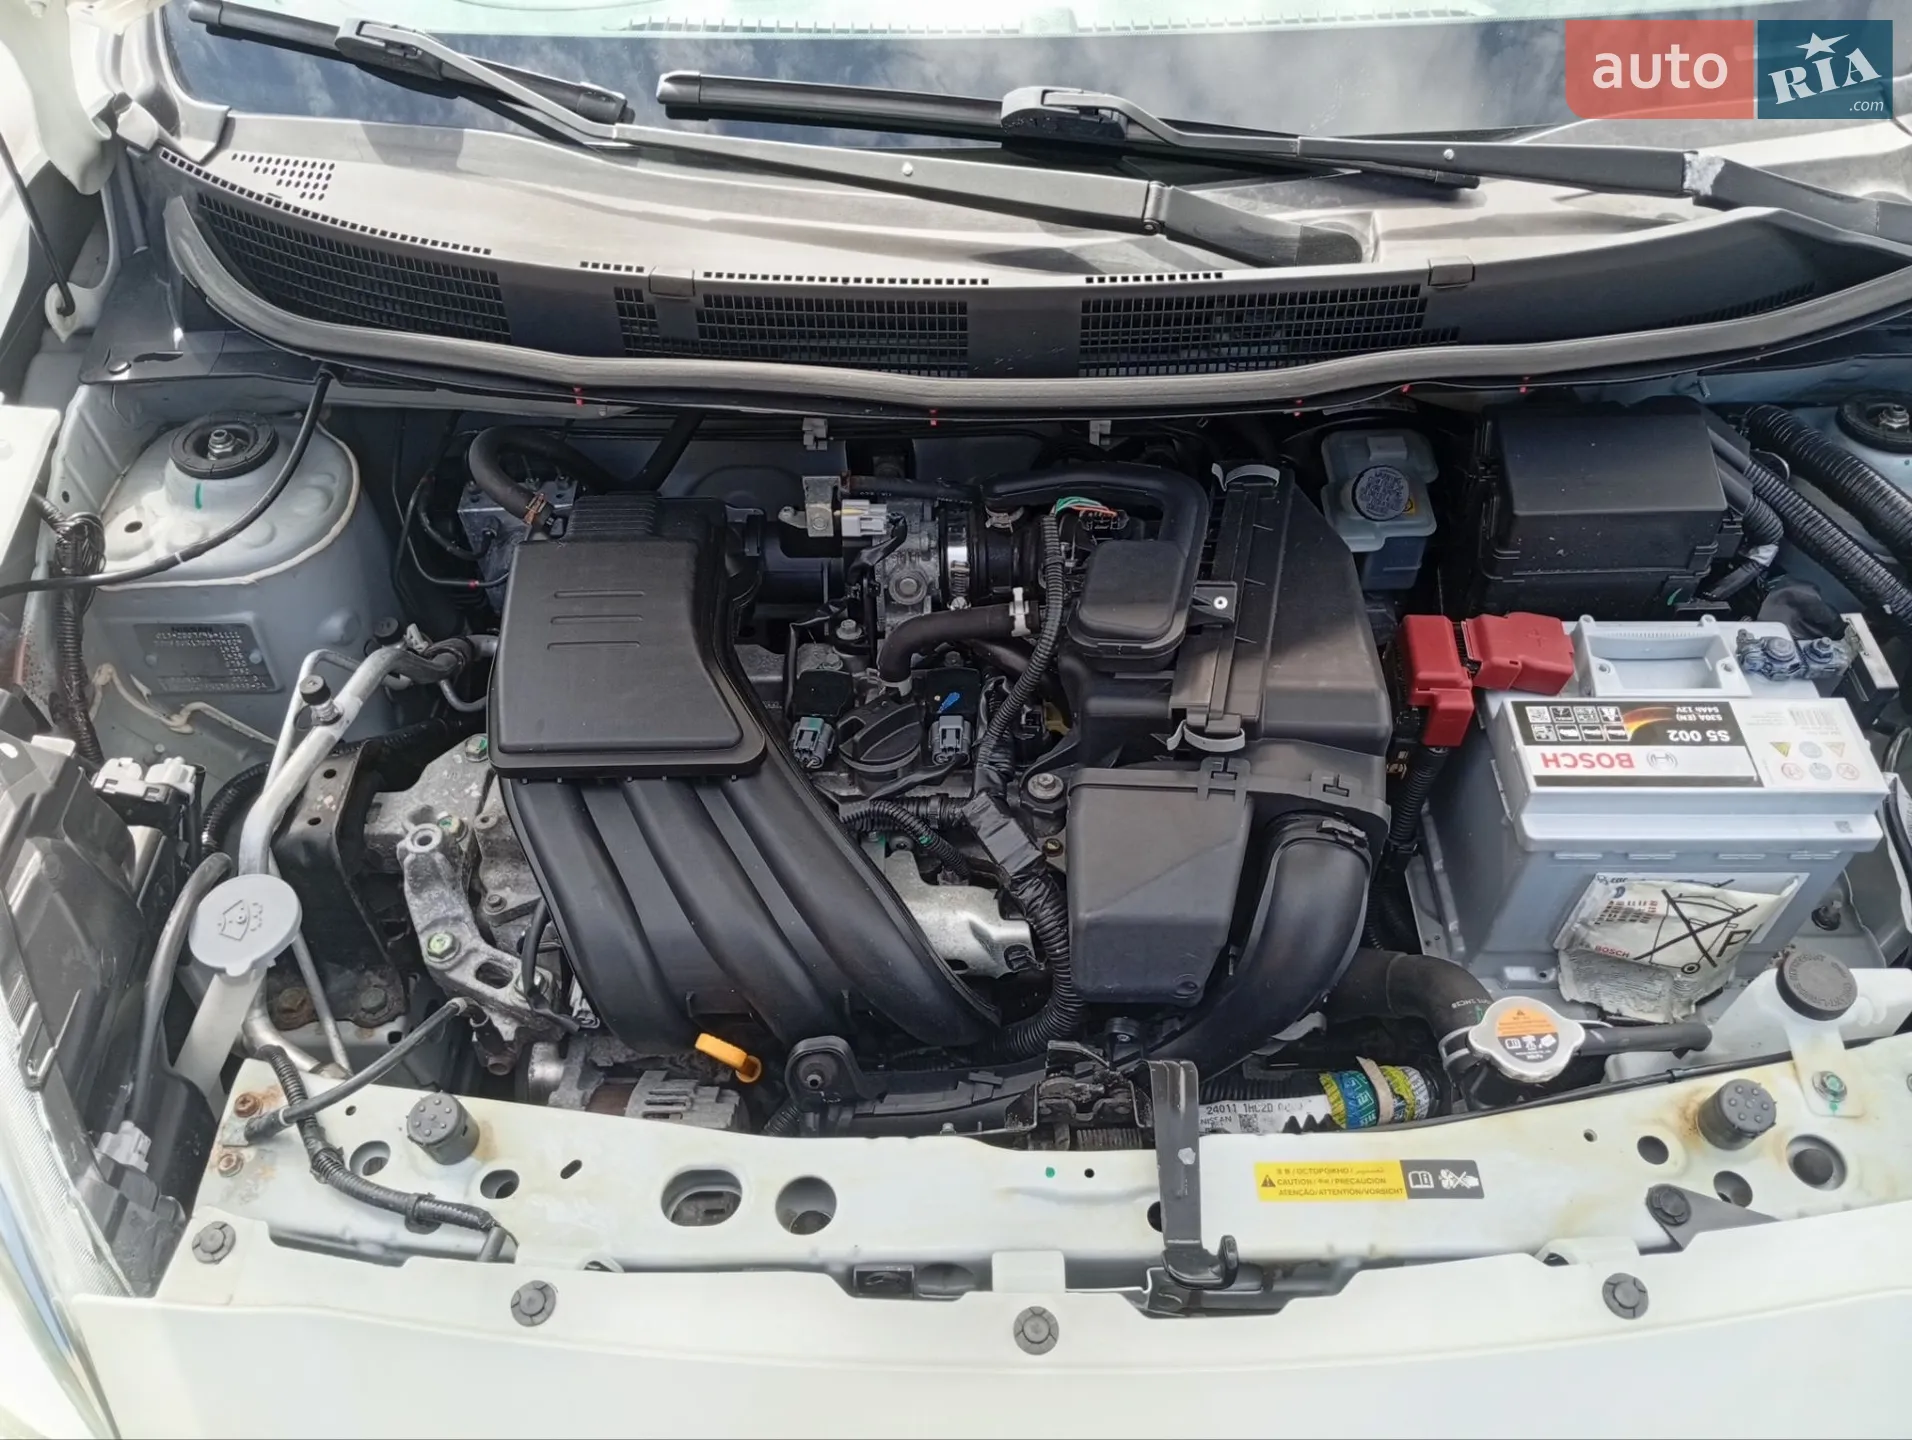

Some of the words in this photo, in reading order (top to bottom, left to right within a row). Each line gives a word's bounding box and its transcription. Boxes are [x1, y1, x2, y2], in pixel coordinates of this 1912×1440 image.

[1675, 713, 1696, 722] (EN)
[1666, 729, 1702, 742] 002
[1706, 729, 1731, 742] S5
[1540, 752, 1635, 769] BOSCH
[1594, 944, 1631, 958] BOSCH
[1206, 1103, 1237, 1115] 24011
[1277, 1178, 1312, 1186] CAUTION
